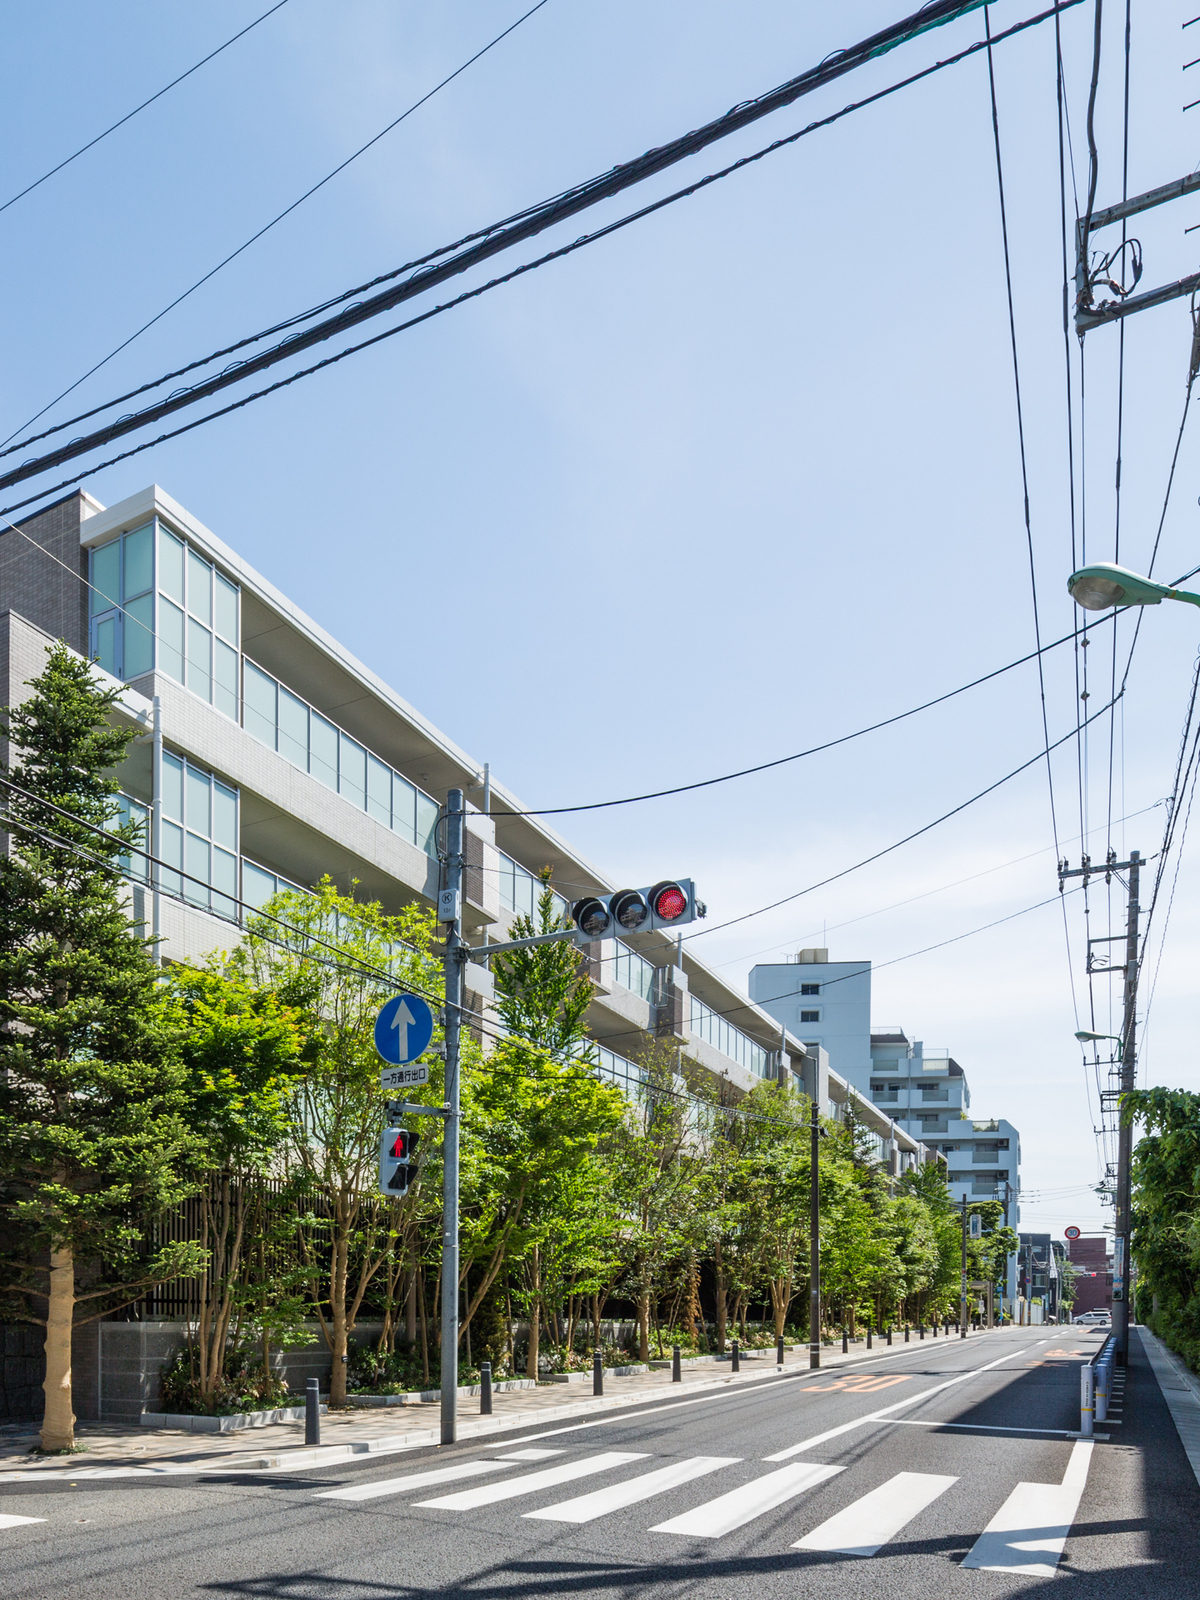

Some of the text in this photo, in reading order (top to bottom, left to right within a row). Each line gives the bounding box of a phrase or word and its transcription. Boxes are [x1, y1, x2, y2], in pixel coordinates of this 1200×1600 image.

[383, 1068, 425, 1085] 一方通行出口
[1067, 1229, 1078, 1237] 30
[799, 1375, 913, 1392] 30
